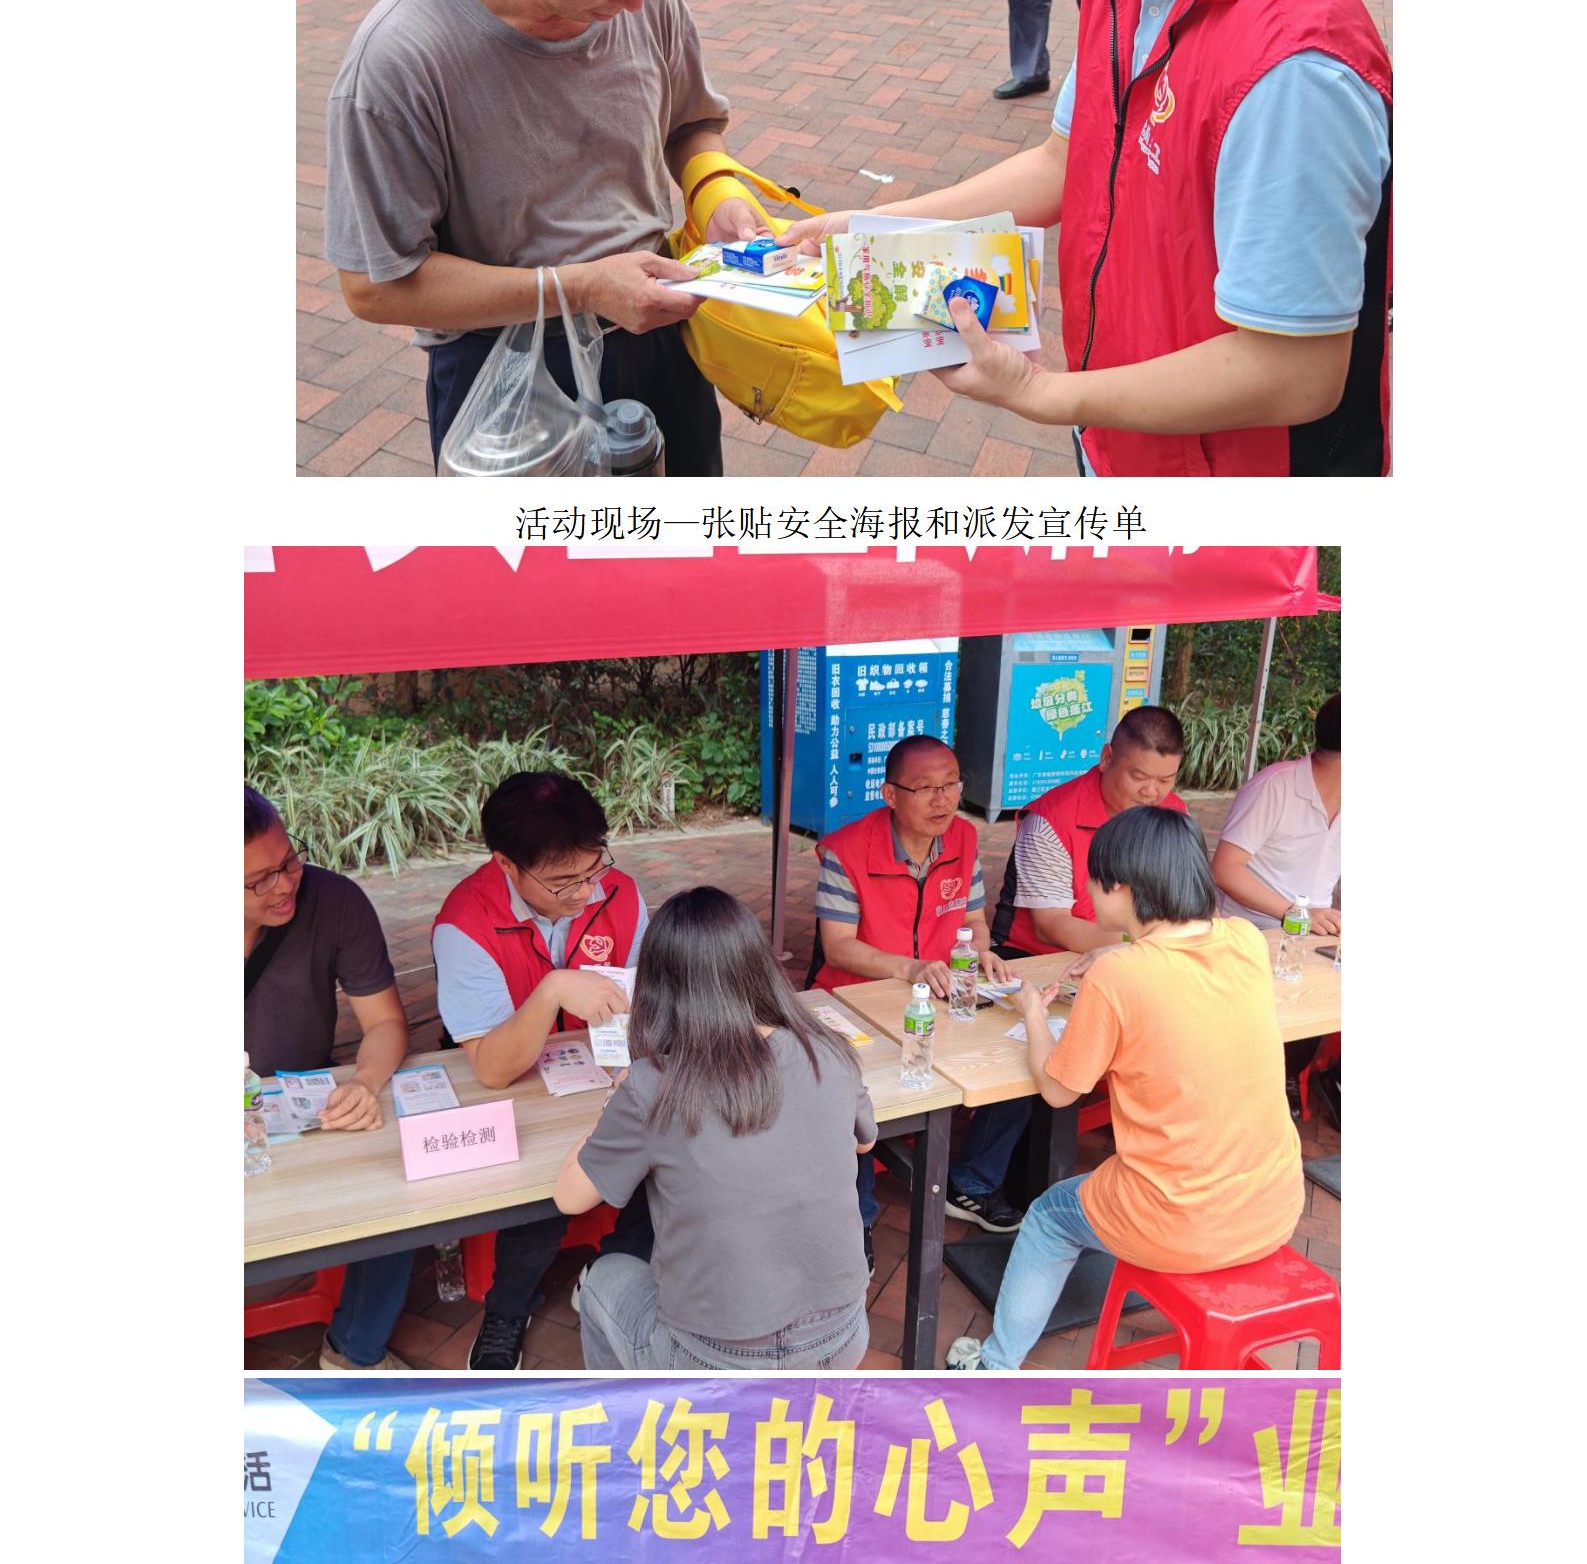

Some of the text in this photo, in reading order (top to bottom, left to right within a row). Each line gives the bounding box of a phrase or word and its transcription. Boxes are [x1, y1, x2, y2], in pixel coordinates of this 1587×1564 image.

[515, 504, 1147, 541] 活动现场—张贴安全海报和派发宣传单
[857, 661, 929, 677] 旧织物回收箱
[830, 663, 841, 710] 旧衣回收
[867, 718, 925, 741] 民政部备案号
[422, 1125, 497, 1154] 检验检测
